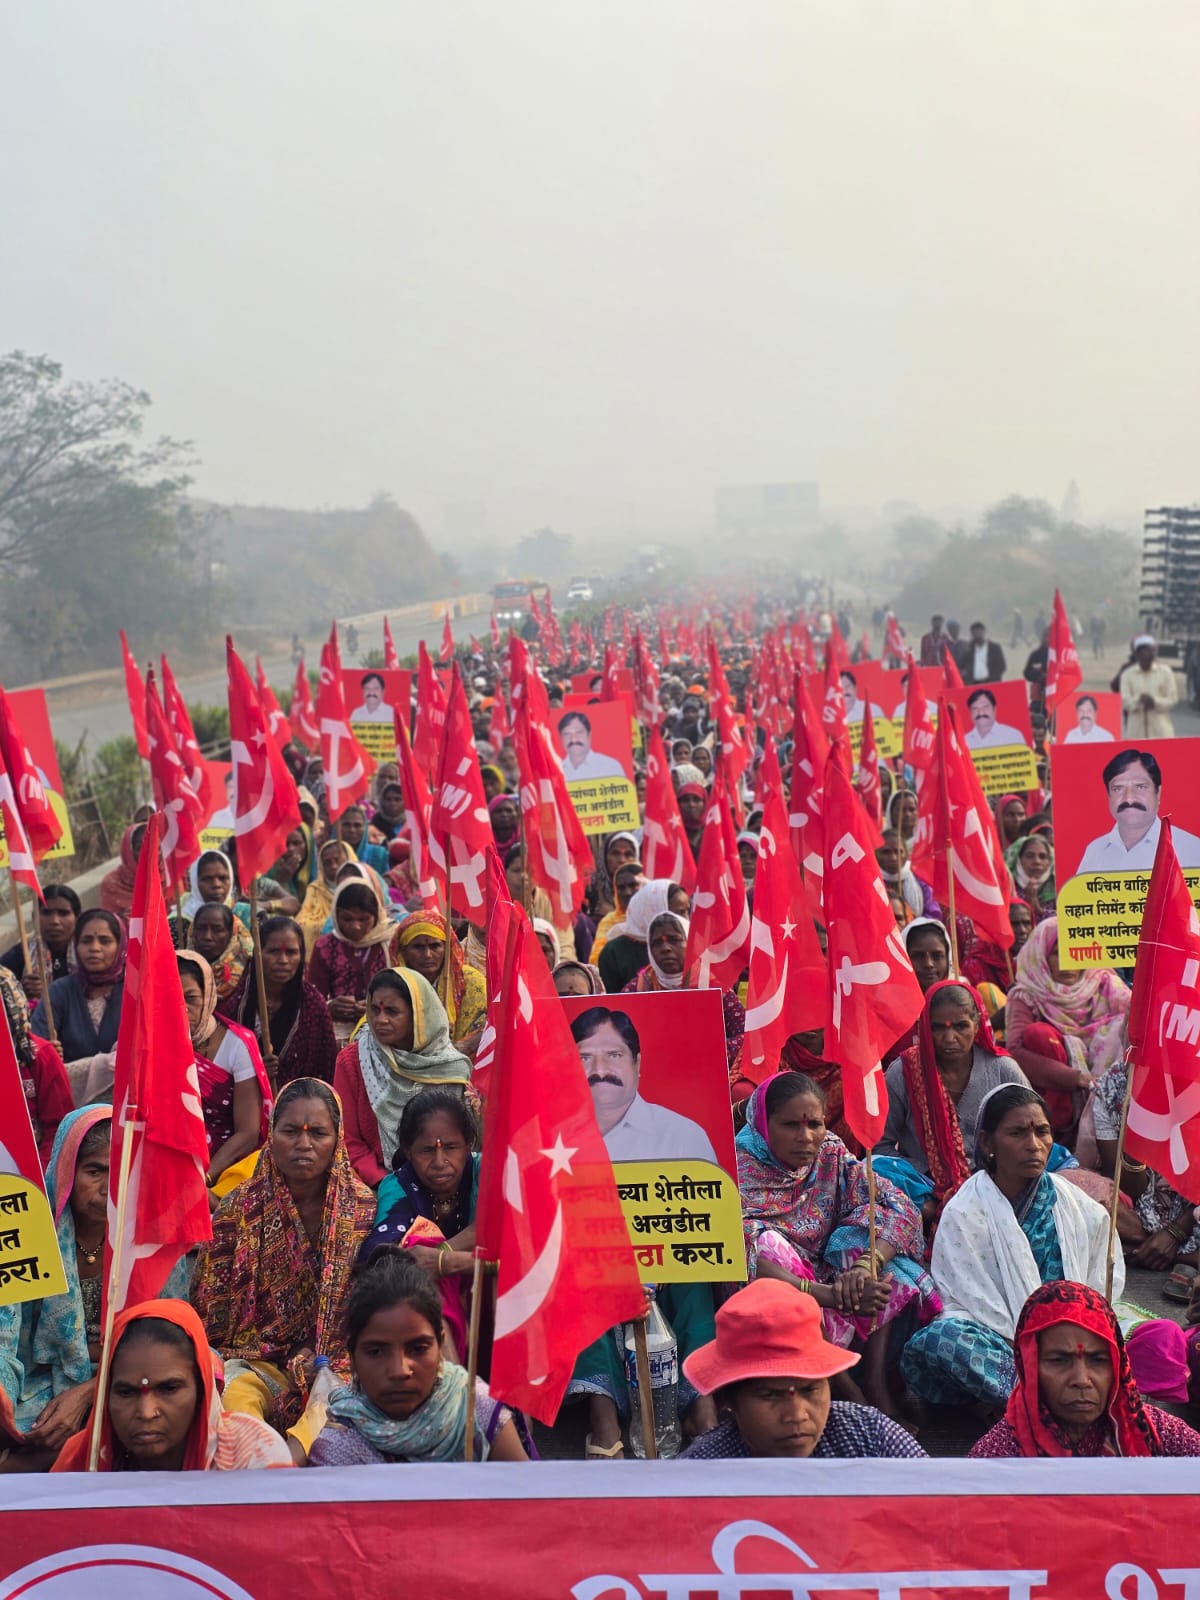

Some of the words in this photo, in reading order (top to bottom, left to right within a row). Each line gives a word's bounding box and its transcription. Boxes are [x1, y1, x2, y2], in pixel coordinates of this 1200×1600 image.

[1086, 876, 1121, 894] पश्चिम
[1065, 904, 1094, 919] लहान
[1096, 898, 1126, 916] सिमेंट
[1068, 926, 1095, 940] प्रथम
[1069, 940, 1102, 962] पाणी
[654, 1174, 722, 1202] शेतीला
[632, 1206, 710, 1234] अखंडीत
[670, 1242, 732, 1266] करा.
